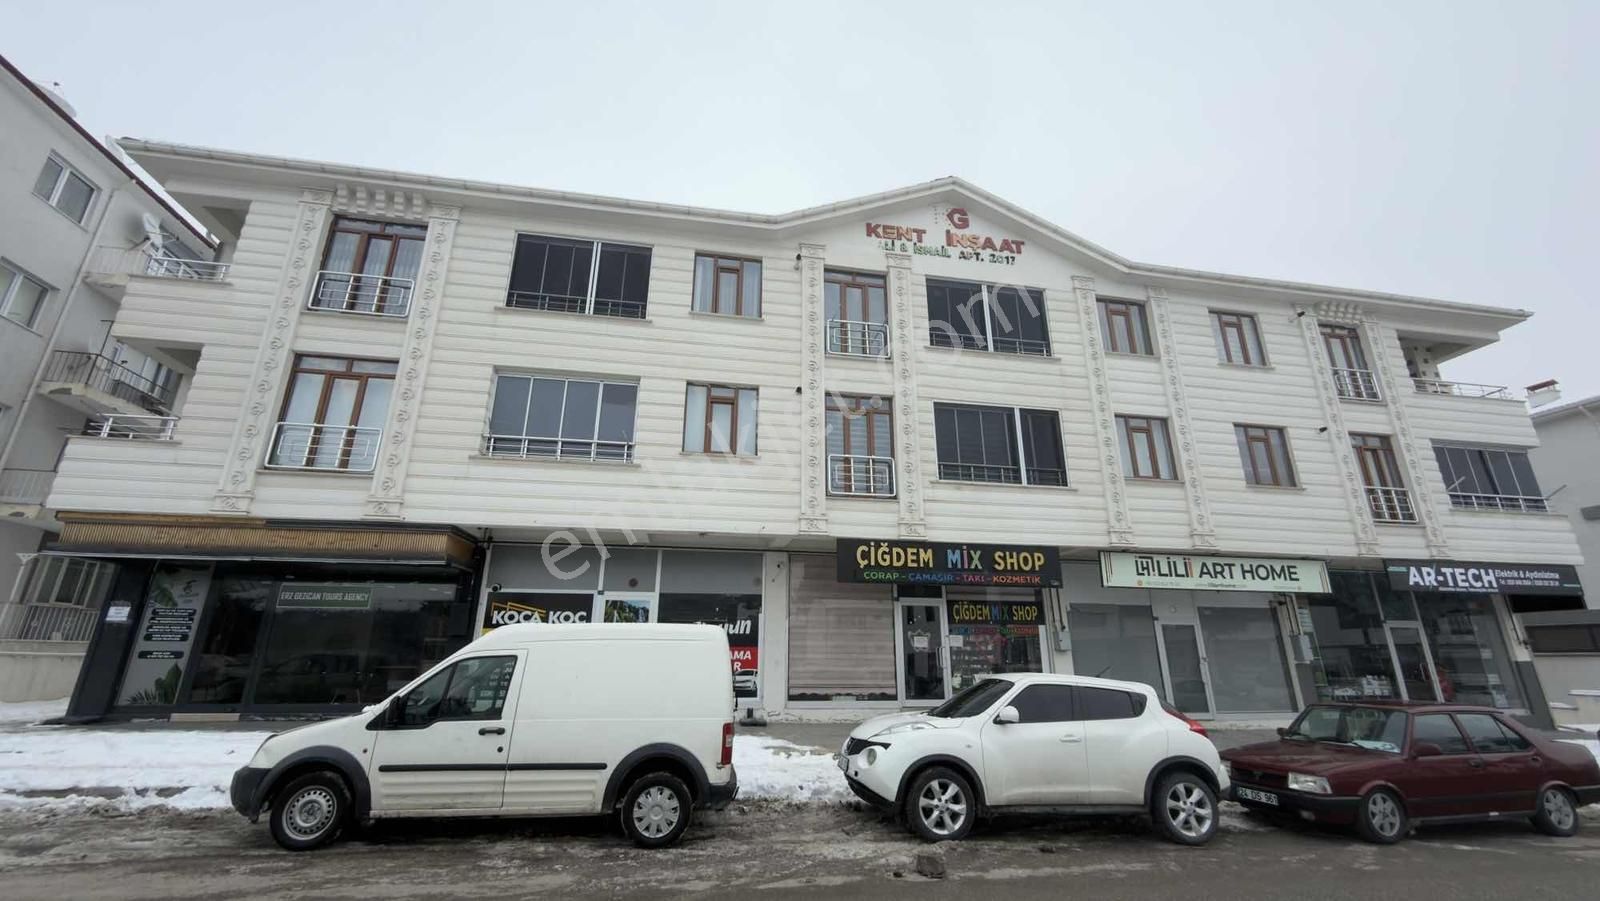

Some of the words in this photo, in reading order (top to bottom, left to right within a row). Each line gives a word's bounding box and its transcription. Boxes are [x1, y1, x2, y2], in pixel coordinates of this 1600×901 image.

[865, 222, 927, 244] KENT
[855, 541, 934, 569] ÇİĞDEM
[946, 545, 983, 570] MİX
[993, 550, 1046, 572] SHOP
[1199, 561, 1236, 579] ART
[1241, 563, 1300, 582] HOME
[1408, 565, 1498, 588] AR-TECH
[492, 610, 543, 625] KOCA
[952, 601, 990, 623] ÇİĞDEM
[1012, 605, 1038, 621] SHOP
